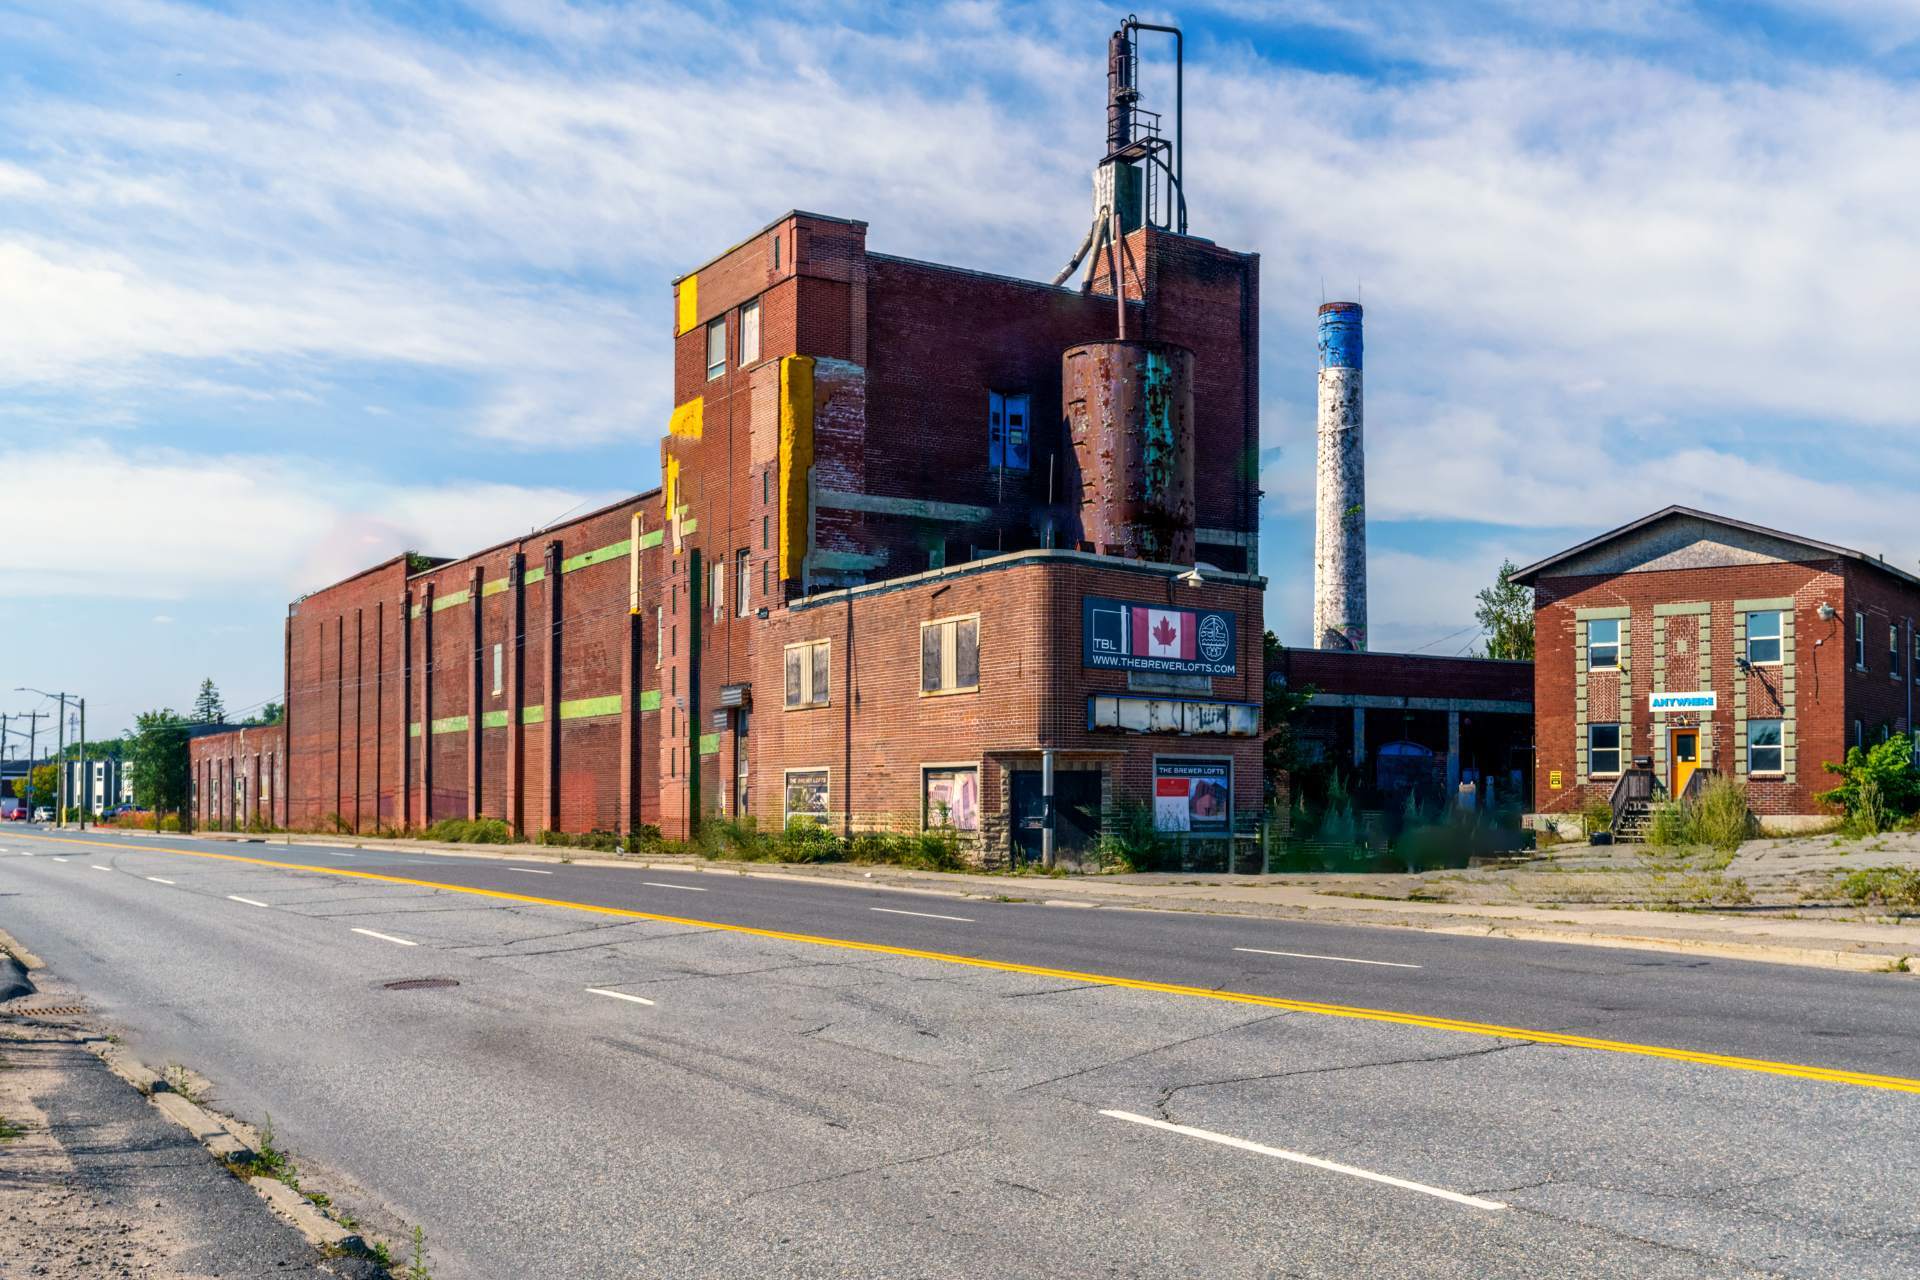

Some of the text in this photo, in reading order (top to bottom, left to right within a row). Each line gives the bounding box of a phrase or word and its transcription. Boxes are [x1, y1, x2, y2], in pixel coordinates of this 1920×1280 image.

[1094, 638, 1117, 650] TBL
[1093, 655, 1236, 674] WWW.THEBREWERLOFTS.COM
[1652, 697, 1714, 707] ANYWHERE
[1174, 767, 1202, 775] BREWER
